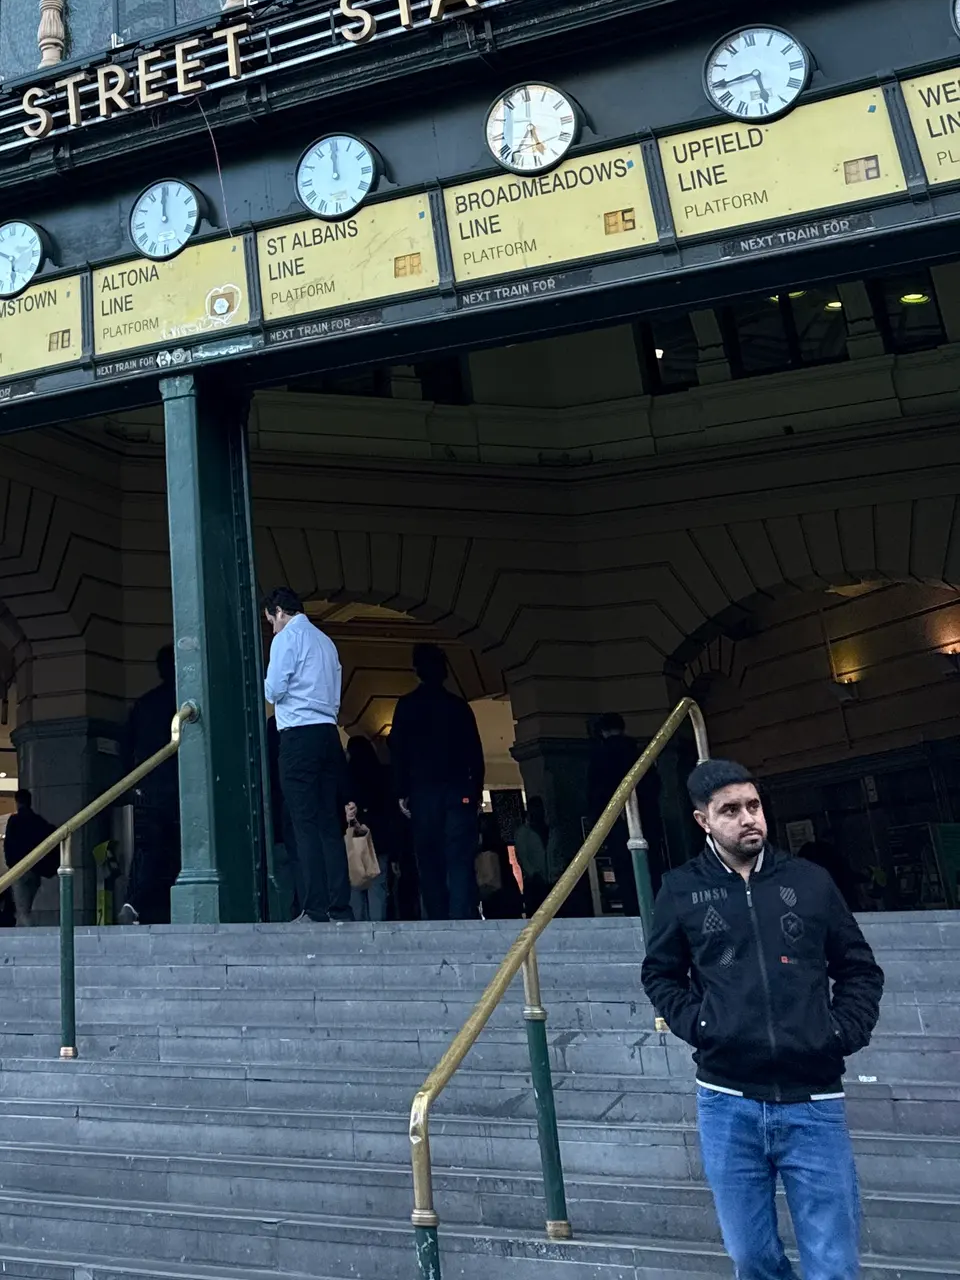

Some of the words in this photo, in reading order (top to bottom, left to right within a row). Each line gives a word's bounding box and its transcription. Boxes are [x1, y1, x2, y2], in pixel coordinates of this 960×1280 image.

[22, 23, 248, 138] STREET
[918, 80, 960, 108] WE
[673, 127, 764, 164] UPFIELD
[455, 158, 628, 214] BROADMEADOWS
[678, 164, 728, 192] LINE
[684, 189, 769, 219] PLATFORM
[267, 235, 287, 256] ST
[292, 220, 359, 251] ALBANS
[459, 215, 502, 240] LINE
[740, 235, 774, 252] NEXT
[778, 224, 820, 244] TRAIN
[823, 219, 850, 236] FOR
[463, 238, 538, 265] PLATFORM
[101, 264, 159, 293] ALTONA
[268, 257, 305, 281] LINE
[271, 280, 336, 305] PLATFORM
[462, 291, 491, 305] NEXT
[494, 282, 530, 299] TRAIN
[533, 278, 556, 293] FOR
[101, 294, 134, 317] LINE
[103, 317, 159, 339] PLATFORM
[270, 329, 295, 342] NEXT
[297, 322, 328, 337] TRAIN
[331, 317, 351, 331] FOR
[97, 365, 113, 376] NEXT
[116, 360, 137, 372] TRAIN
[140, 356, 154, 367] FOR
